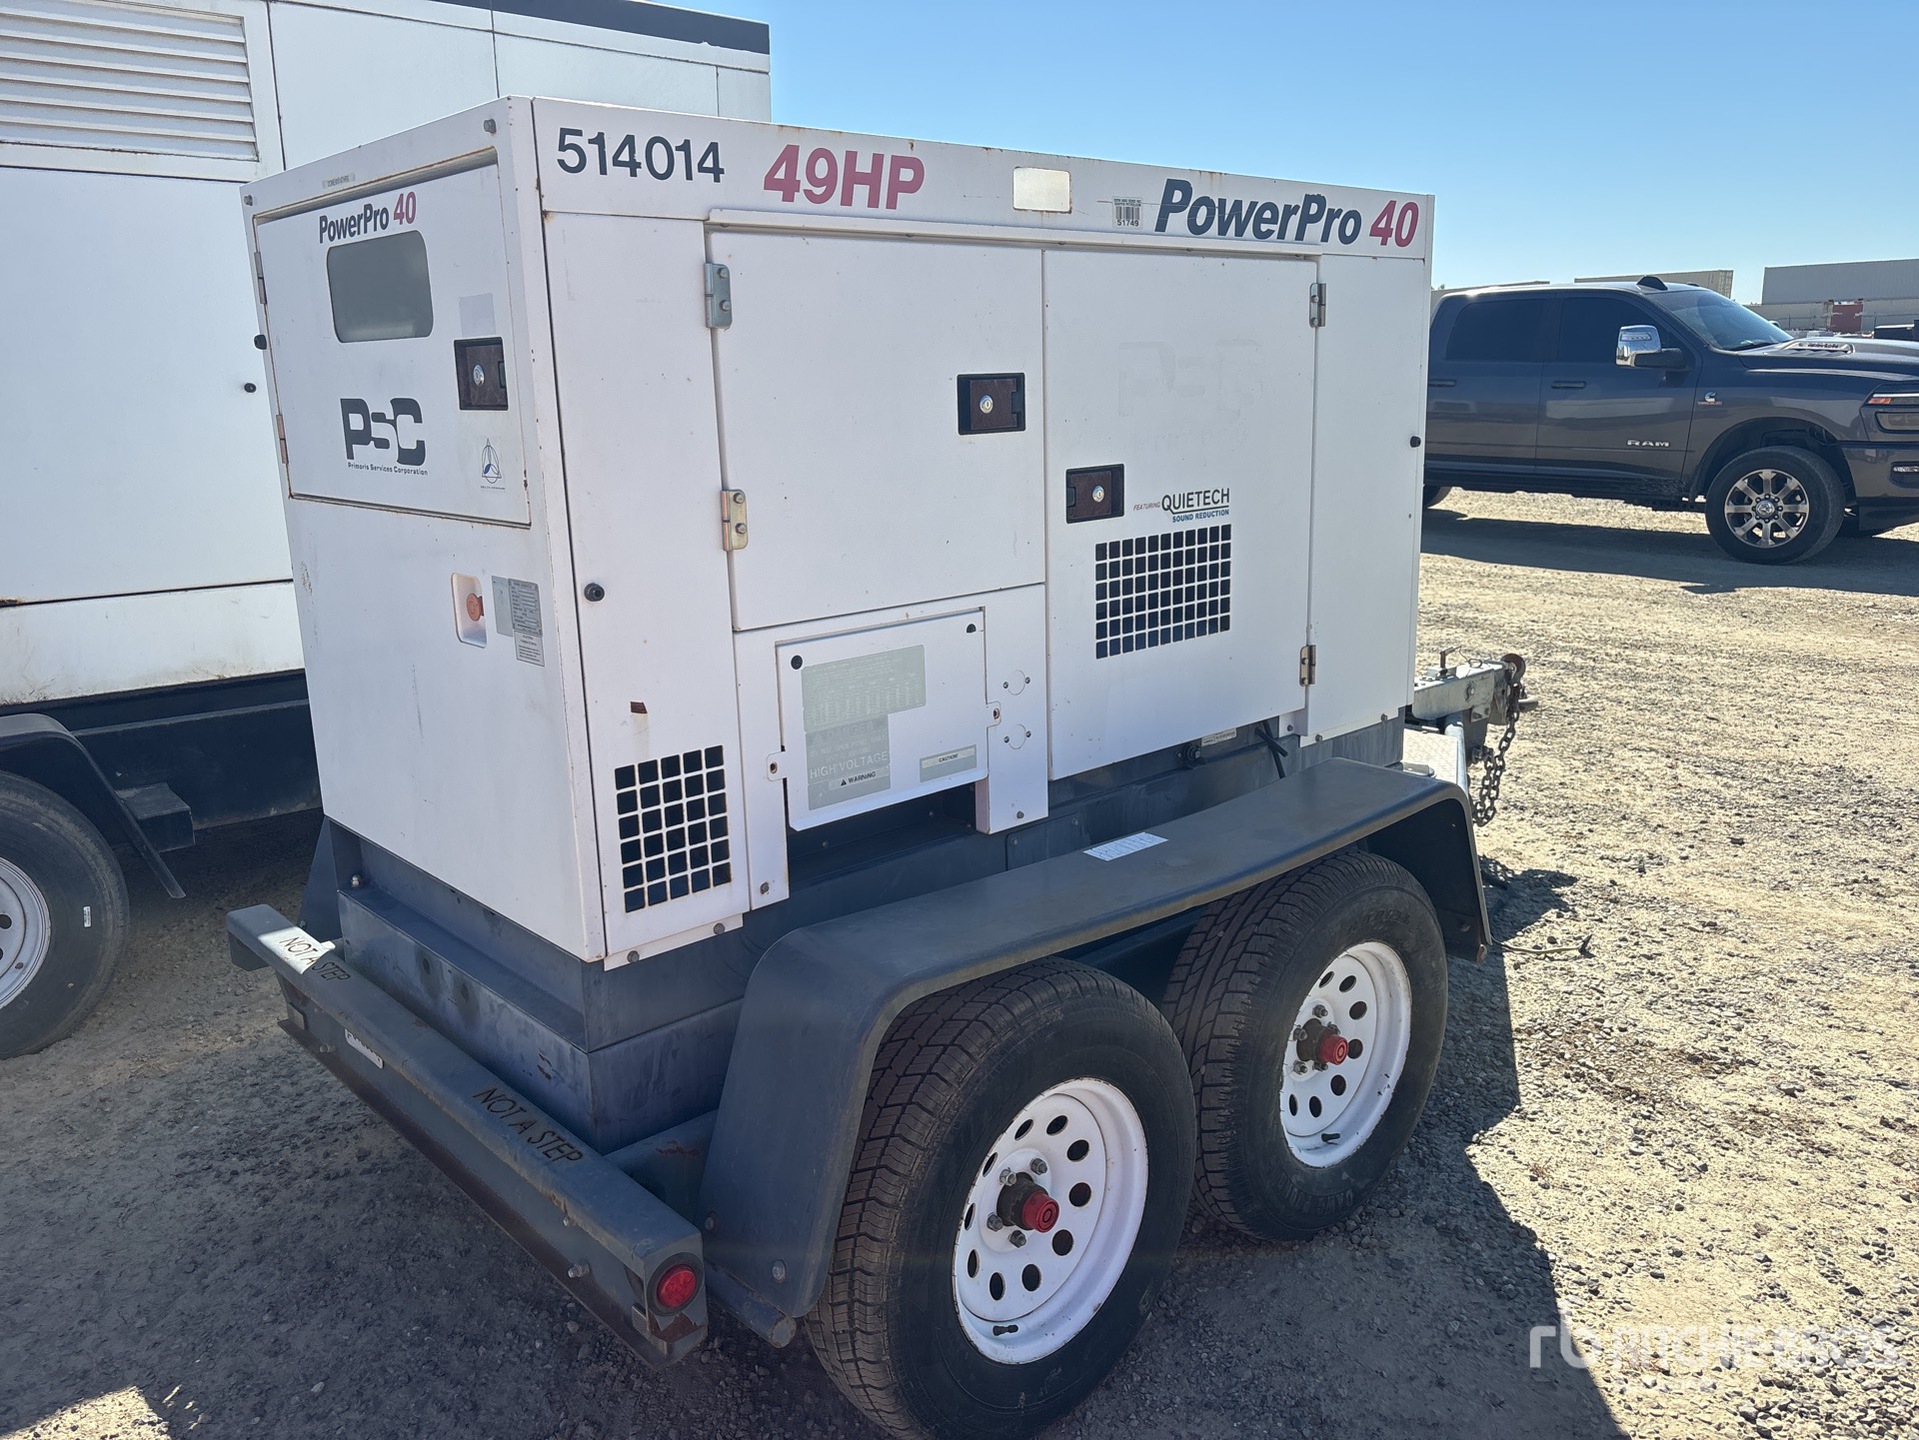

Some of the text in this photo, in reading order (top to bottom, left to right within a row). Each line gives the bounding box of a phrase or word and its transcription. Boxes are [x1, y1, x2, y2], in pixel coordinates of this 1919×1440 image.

[557, 127, 725, 183] 514014
[763, 143, 925, 211] 49HP
[319, 191, 417, 244] PowerPro 40
[1116, 219, 1139, 227] 51749
[1154, 178, 1419, 248] PowerPro 40
[340, 397, 426, 467] PSC
[1627, 439, 1670, 448] RAM
[347, 461, 428, 476] Primoris Services Corporation
[1133, 488, 1230, 512] FEATURING QUIETECH
[1172, 509, 1230, 523] SOUND REDUCTION
[810, 751, 889, 780] HIGH VOLTAGE
[848, 771, 876, 784] WARNING
[279, 936, 319, 957] NOT
[312, 961, 351, 981] STEP
[472, 1087, 584, 1162] NOT A STEP
